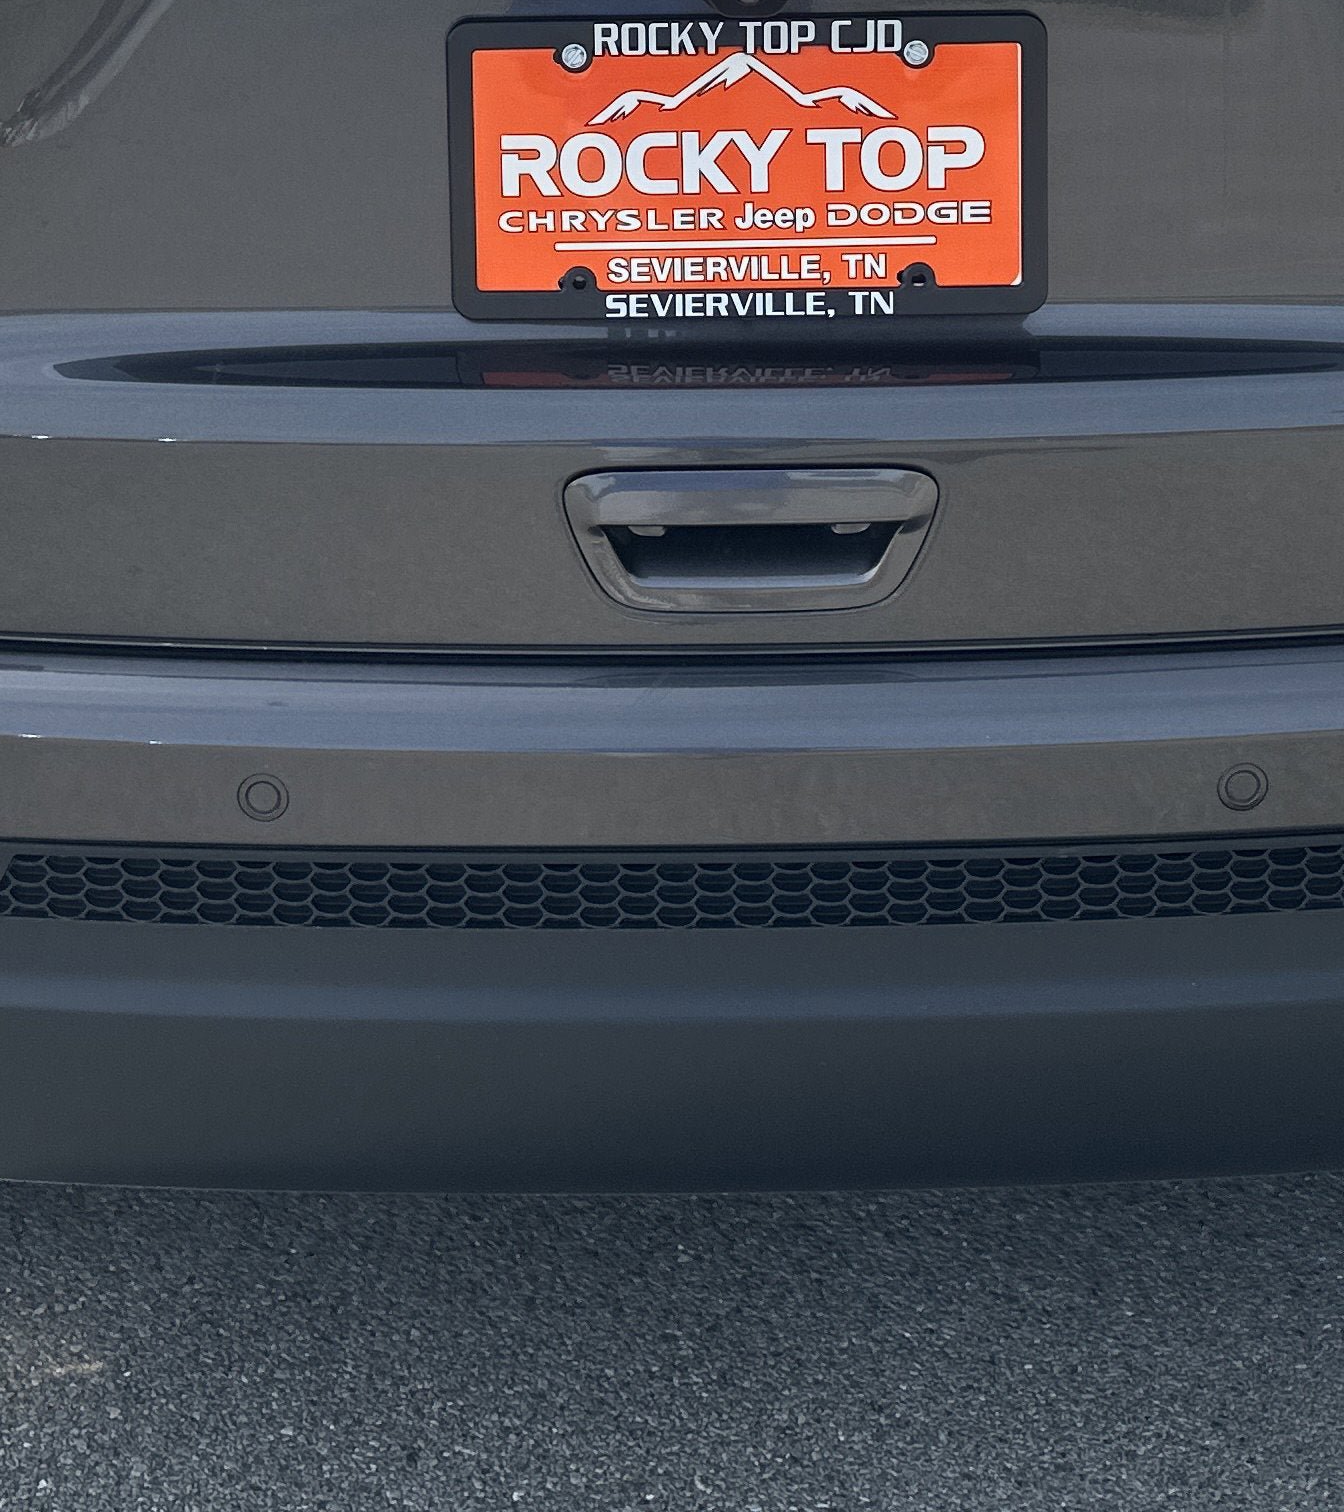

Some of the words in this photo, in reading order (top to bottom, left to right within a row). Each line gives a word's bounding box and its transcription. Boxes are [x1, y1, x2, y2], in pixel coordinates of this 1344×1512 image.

[593, 22, 724, 56] ROCKY
[739, 20, 816, 54] TOP
[830, 19, 903, 53] CJD
[500, 129, 793, 198] ROCKY
[806, 125, 986, 193] TOP
[498, 208, 727, 234] CHRYSLER
[734, 202, 816, 232] Jeep
[827, 200, 992, 226] DODGE
[607, 254, 831, 285] SEVIERVILLE,
[841, 252, 888, 279] TN
[605, 291, 836, 318] SEVIERVILLE,
[848, 290, 895, 316] TN
